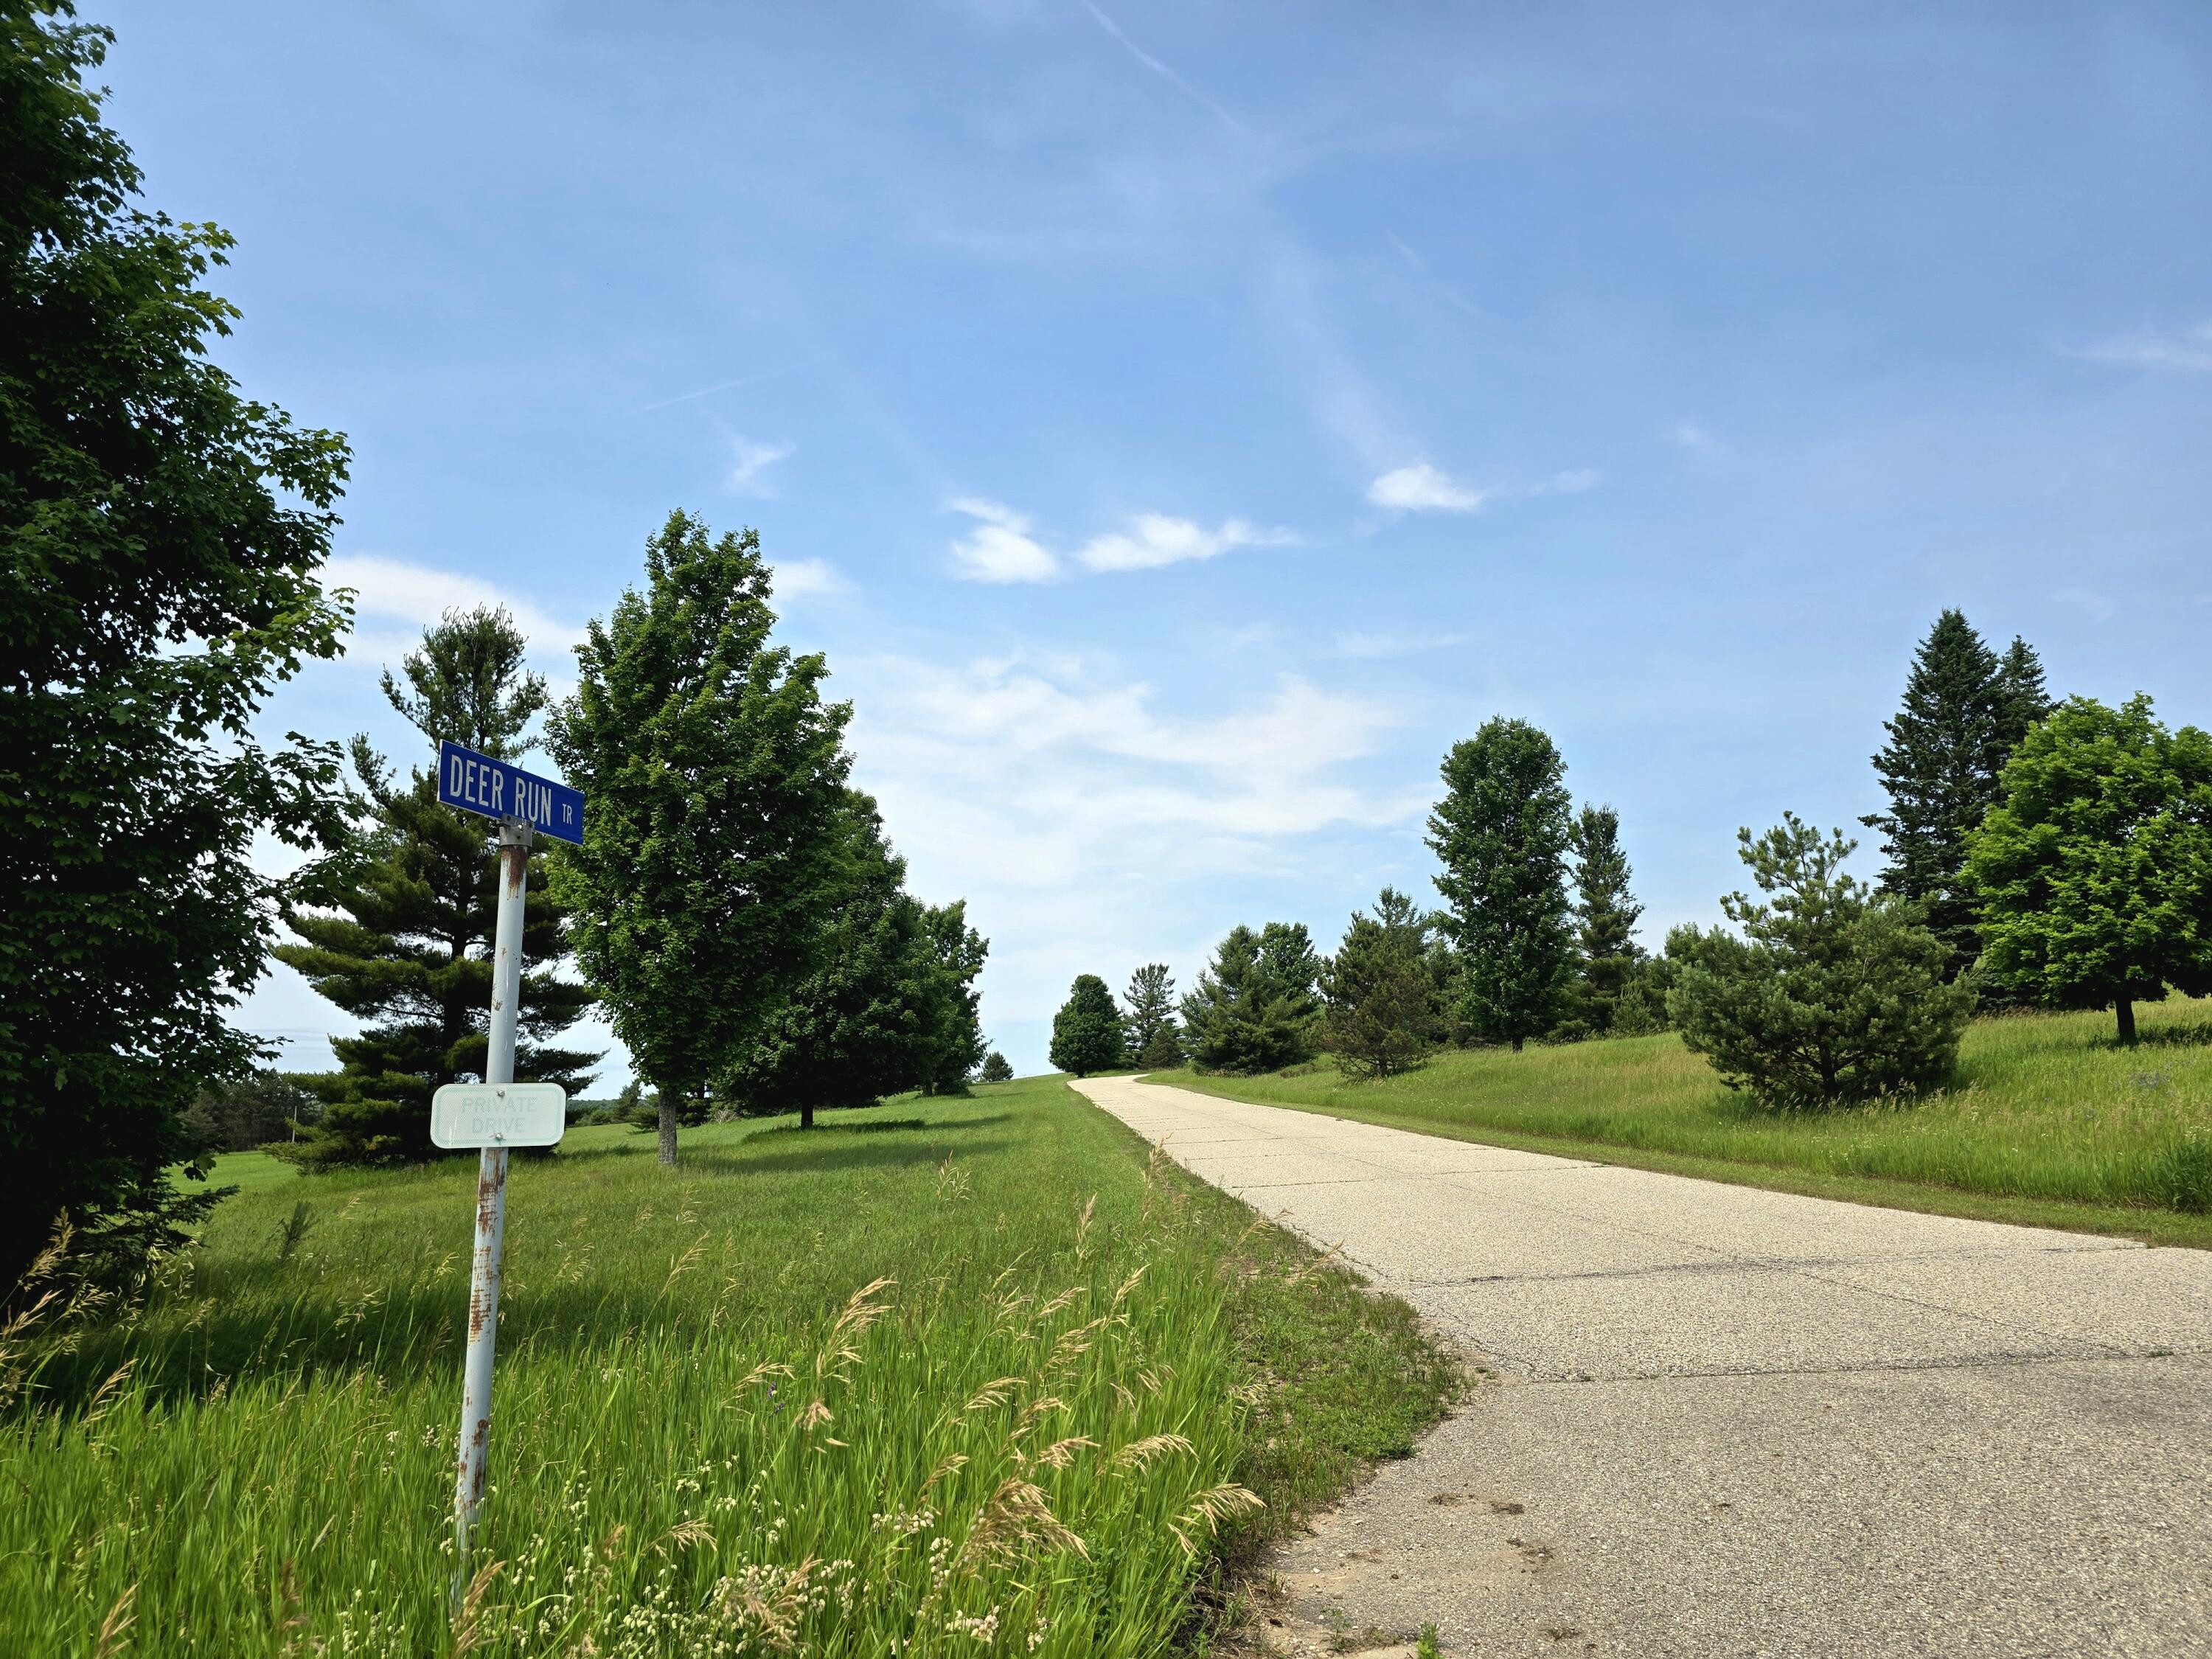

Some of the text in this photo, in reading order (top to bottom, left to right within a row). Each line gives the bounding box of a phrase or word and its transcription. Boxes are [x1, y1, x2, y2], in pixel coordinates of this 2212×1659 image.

[450, 754, 572, 827] DEER RUN TR
[461, 1096, 537, 1113] PRIVATE
[472, 1118, 526, 1133] DRIVE
